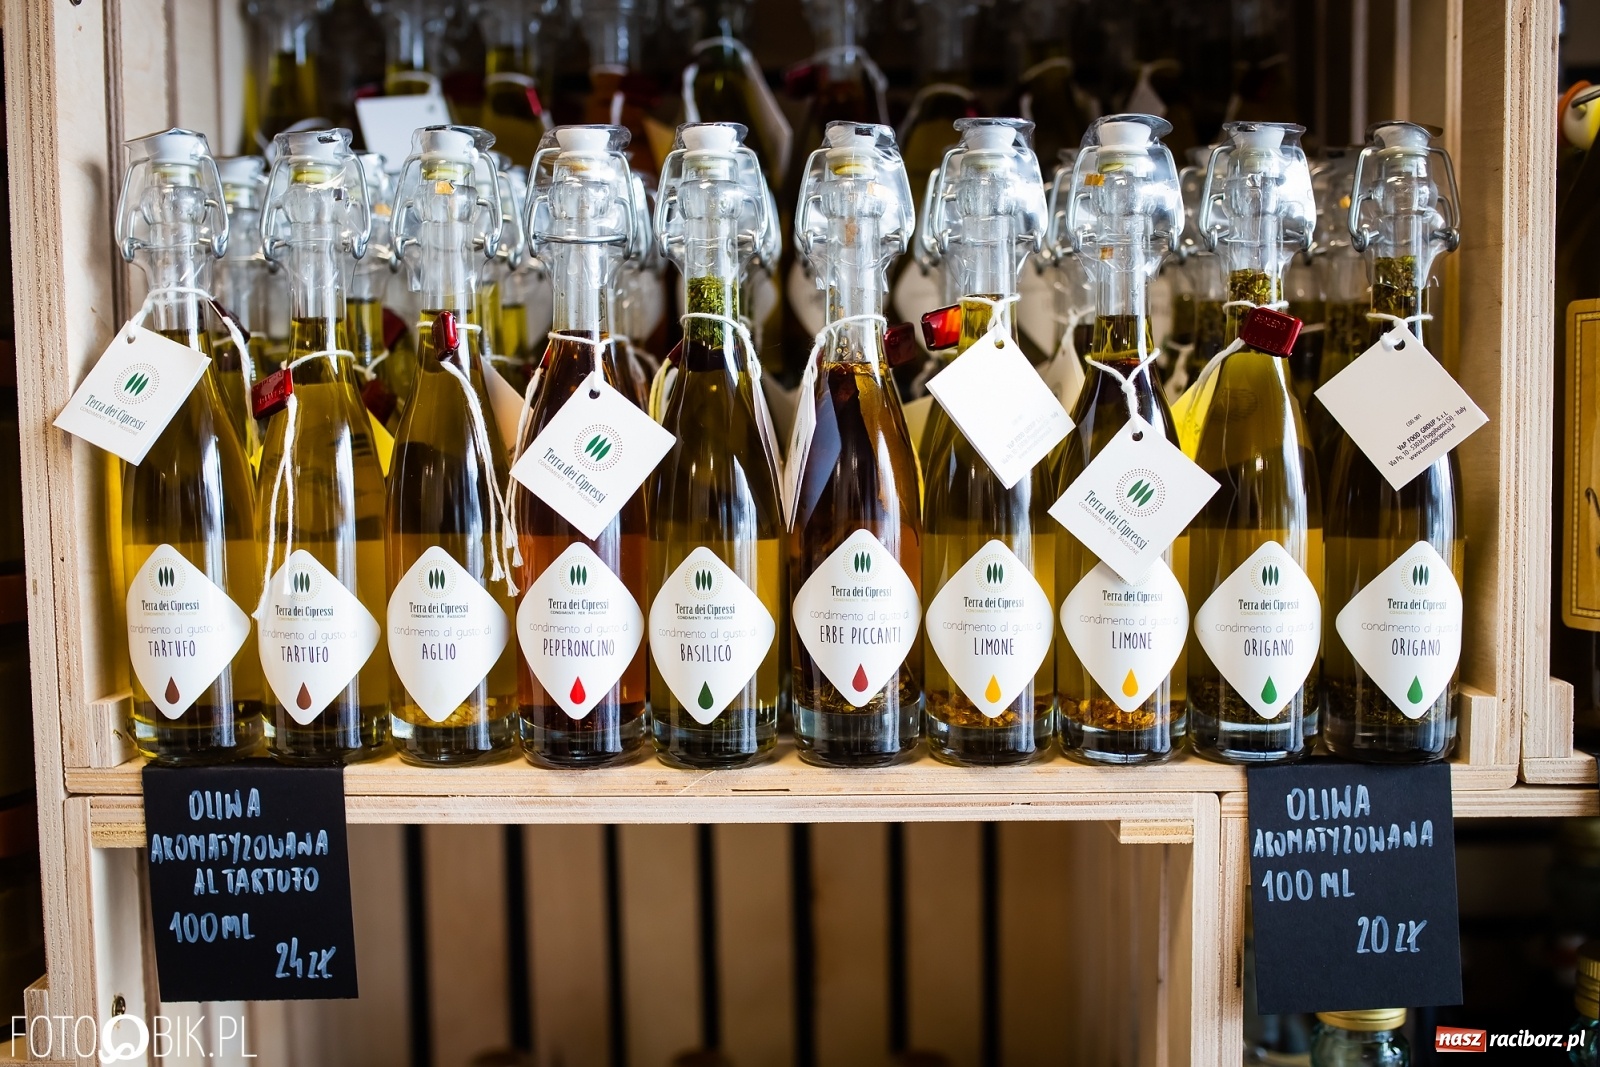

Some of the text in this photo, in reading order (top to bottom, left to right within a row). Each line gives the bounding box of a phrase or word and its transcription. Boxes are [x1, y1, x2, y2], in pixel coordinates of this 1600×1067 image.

[85, 394, 148, 430] Terra dei Cipressi
[1455, 405, 1467, 417] Italy
[1408, 432, 1420, 444] FOOD
[1420, 420, 1436, 434] GROUP
[543, 448, 608, 504] Terra dei Cipressi
[566, 481, 576, 490] PER
[1084, 490, 1150, 550] Terra dei Cipressi
[1078, 501, 1140, 556] CONDIMENTI PER PASSIONE
[831, 586, 892, 598] Terra dei Cipressi
[1102, 590, 1163, 604] Terra dei Cipressi
[141, 600, 200, 612] Terra dei Cipressi
[409, 602, 468, 615] Terra dei Cipressi
[548, 598, 609, 612] Terra dei Cipressi
[675, 604, 736, 616] Terra dei Cipressi
[964, 596, 1024, 610] Terra dei Cipressi
[1238, 598, 1299, 612] Terra dei Cipressi
[1388, 598, 1447, 612] Terra dei Cipressi
[275, 605, 334, 618] Terra dei Cipressi
[810, 610, 864, 621] condimento
[868, 611, 876, 620] al
[530, 622, 580, 634] condimento
[584, 624, 592, 634] al
[942, 620, 996, 633] condimento
[1000, 622, 1008, 632] al
[1080, 614, 1134, 626] condimento
[1138, 616, 1146, 626] al
[1215, 622, 1272, 634] condimento
[1276, 623, 1284, 634] al
[1362, 622, 1420, 633] condimento
[1424, 624, 1432, 634] al
[130, 624, 170, 634] condimento
[174, 624, 182, 634] al
[188, 624, 214, 637] gusto
[308, 630, 317, 640] al
[321, 630, 346, 643] gusto
[394, 625, 492, 640] condimento al gusto di
[658, 628, 706, 639] condimento
[710, 628, 719, 638] al
[723, 629, 746, 642] gusto
[820, 624, 901, 645] ERBE PICCANTI
[544, 638, 614, 657] PEPERONCINO
[974, 637, 1014, 656] LIMONE
[1112, 630, 1152, 650] LIMONE
[1244, 638, 1294, 657] ORIGANO
[1392, 637, 1440, 656] ORIGANO
[148, 640, 196, 658] TARTUFO
[281, 645, 328, 663] TARTUFO
[422, 642, 456, 660] AGLIO
[680, 643, 732, 662] BASILICO
[188, 788, 261, 821] OLIWA
[1286, 784, 1371, 821] OLIWA
[151, 829, 328, 864] AROMATYZOWANA
[1253, 819, 1434, 858] AROMATYZOWANA
[193, 866, 320, 896] AL TARTUFO
[1356, 915, 1390, 954] 20
[275, 937, 303, 979] 24
